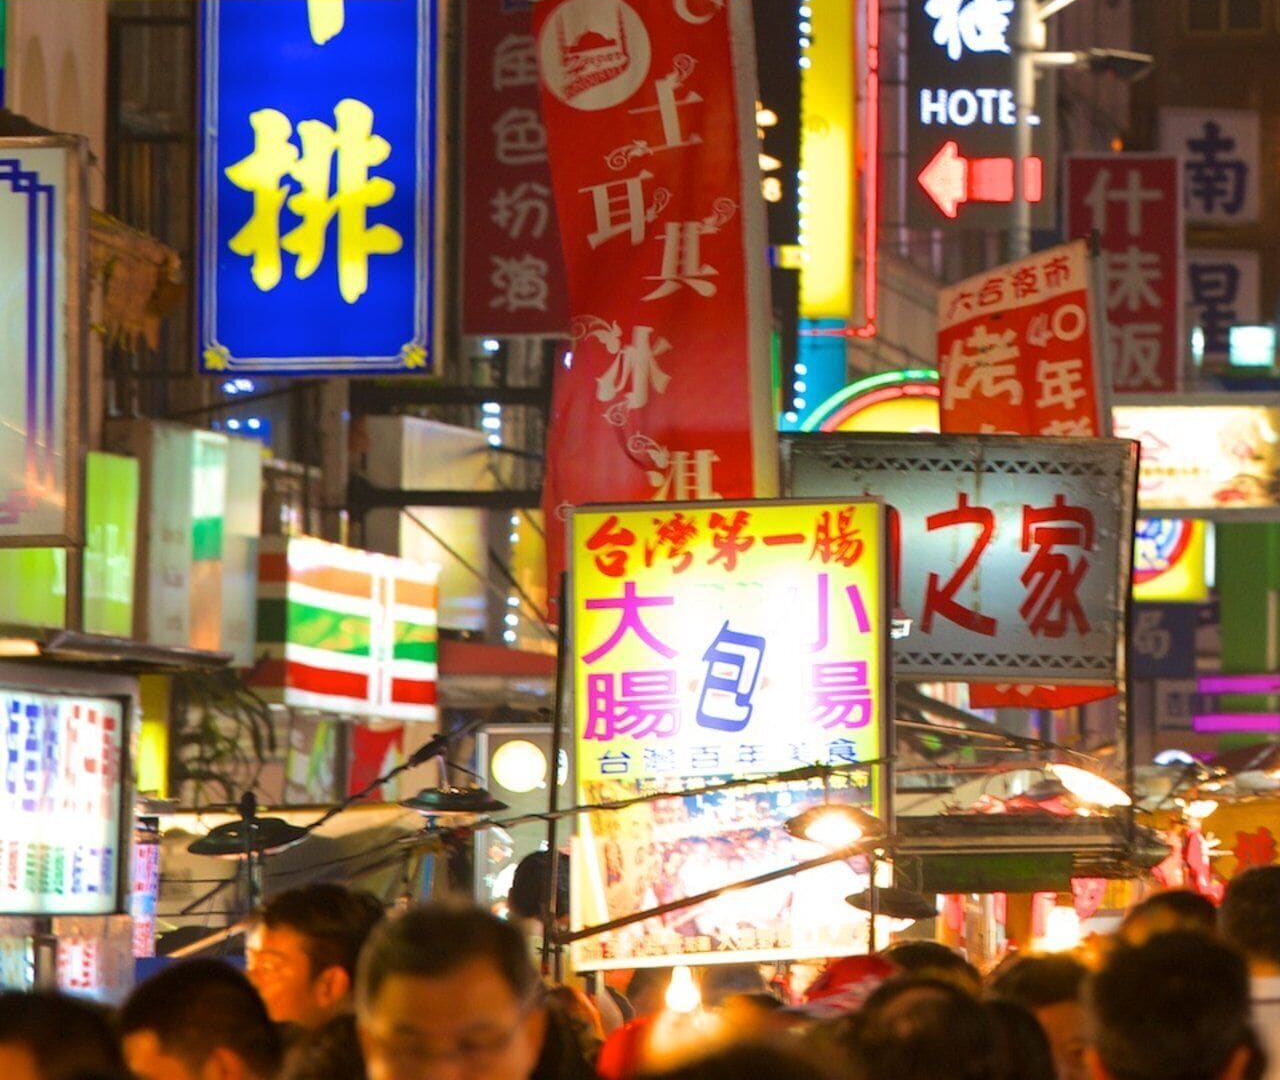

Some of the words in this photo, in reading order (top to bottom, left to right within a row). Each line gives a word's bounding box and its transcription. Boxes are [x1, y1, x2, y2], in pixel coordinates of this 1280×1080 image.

[941, 325, 1024, 436] 烤
[585, 506, 866, 579] 台灣第一腸
[890, 493, 1094, 639] 之家
